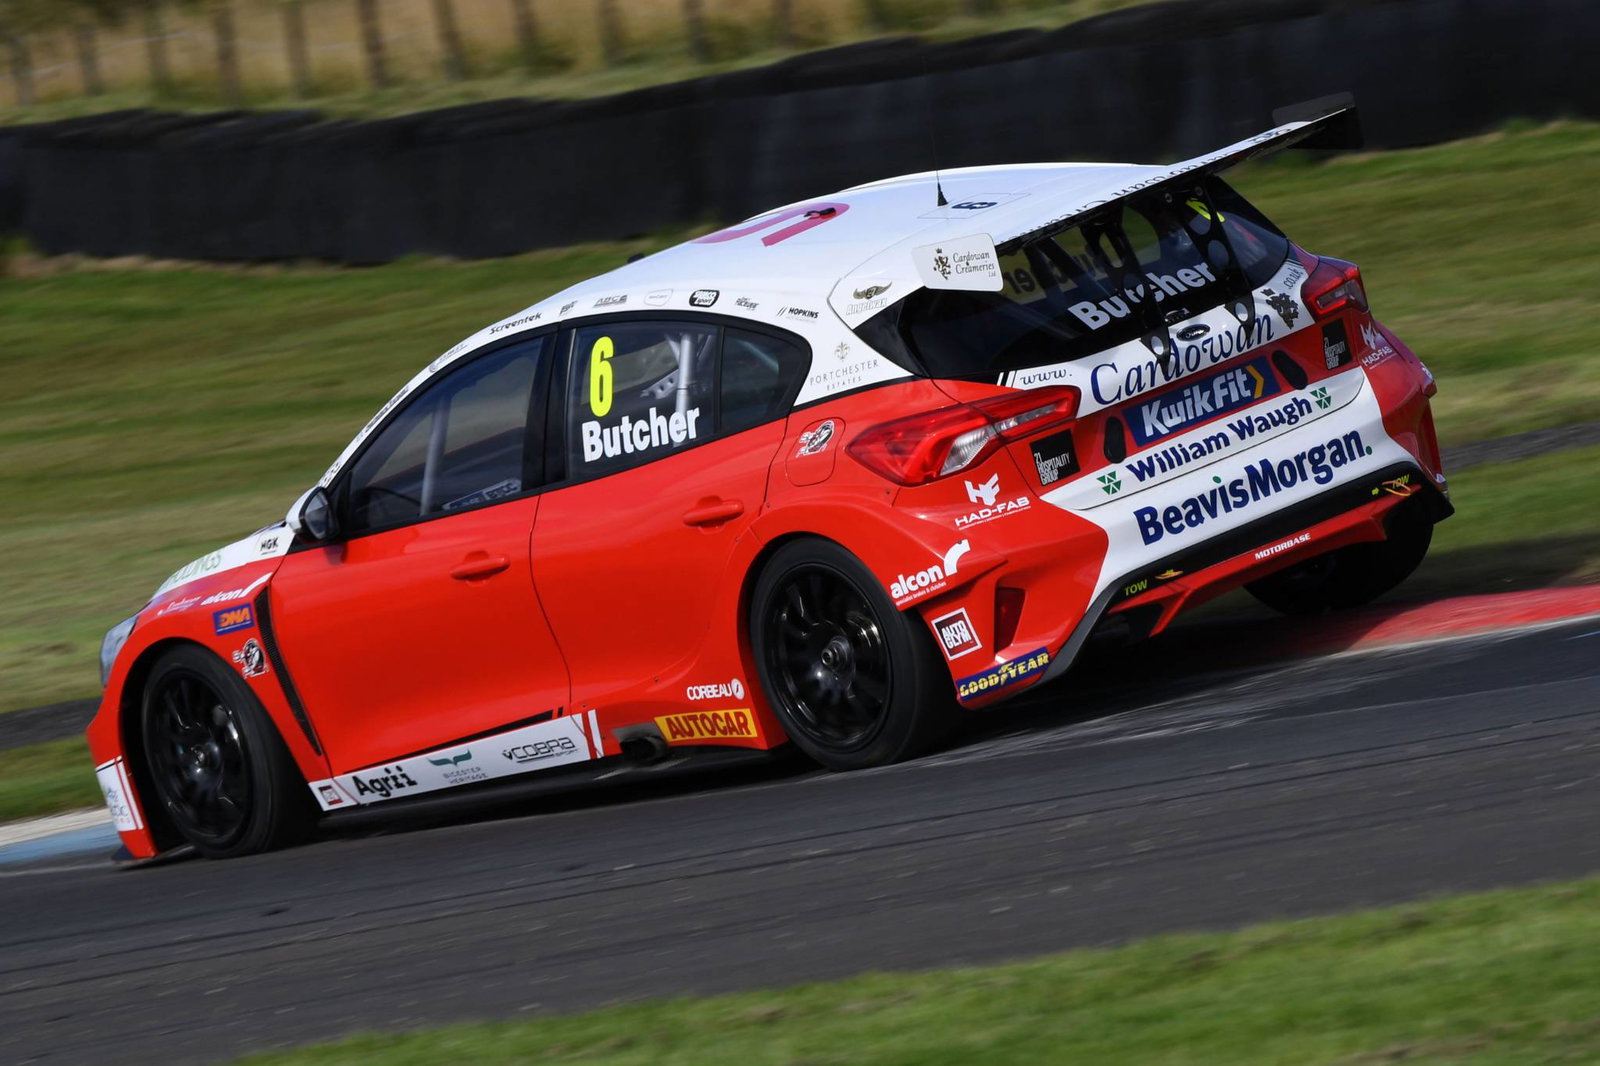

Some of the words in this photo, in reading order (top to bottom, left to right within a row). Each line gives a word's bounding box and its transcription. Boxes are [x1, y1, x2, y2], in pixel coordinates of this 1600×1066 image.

[952, 251, 990, 264] Cardowan
[955, 261, 995, 275] Creameries
[788, 307, 819, 319] HOPKINS
[590, 336, 614, 417] 6
[810, 359, 880, 386] PORTCHESTER
[827, 376, 862, 391] ESTATES
[1020, 368, 1073, 385] www.
[582, 407, 700, 462] Butcher
[1125, 431, 1230, 483] William
[1227, 397, 1313, 441] Waugh
[1037, 452, 1071, 474] HOSPITALITY
[954, 496, 1030, 527] HAD-FAB
[1254, 532, 1312, 561] MOTORBASE
[890, 565, 944, 599] alcon
[1124, 579, 1148, 596] TOW
[219, 608, 250, 628] DNA
[941, 620, 966, 639] AUTO
[944, 632, 972, 649] GLYM
[959, 653, 1049, 697] GOODYEAR
[687, 683, 733, 700] CORBEAU
[665, 711, 752, 739] AUTOCAR
[352, 765, 418, 798] Agrii
